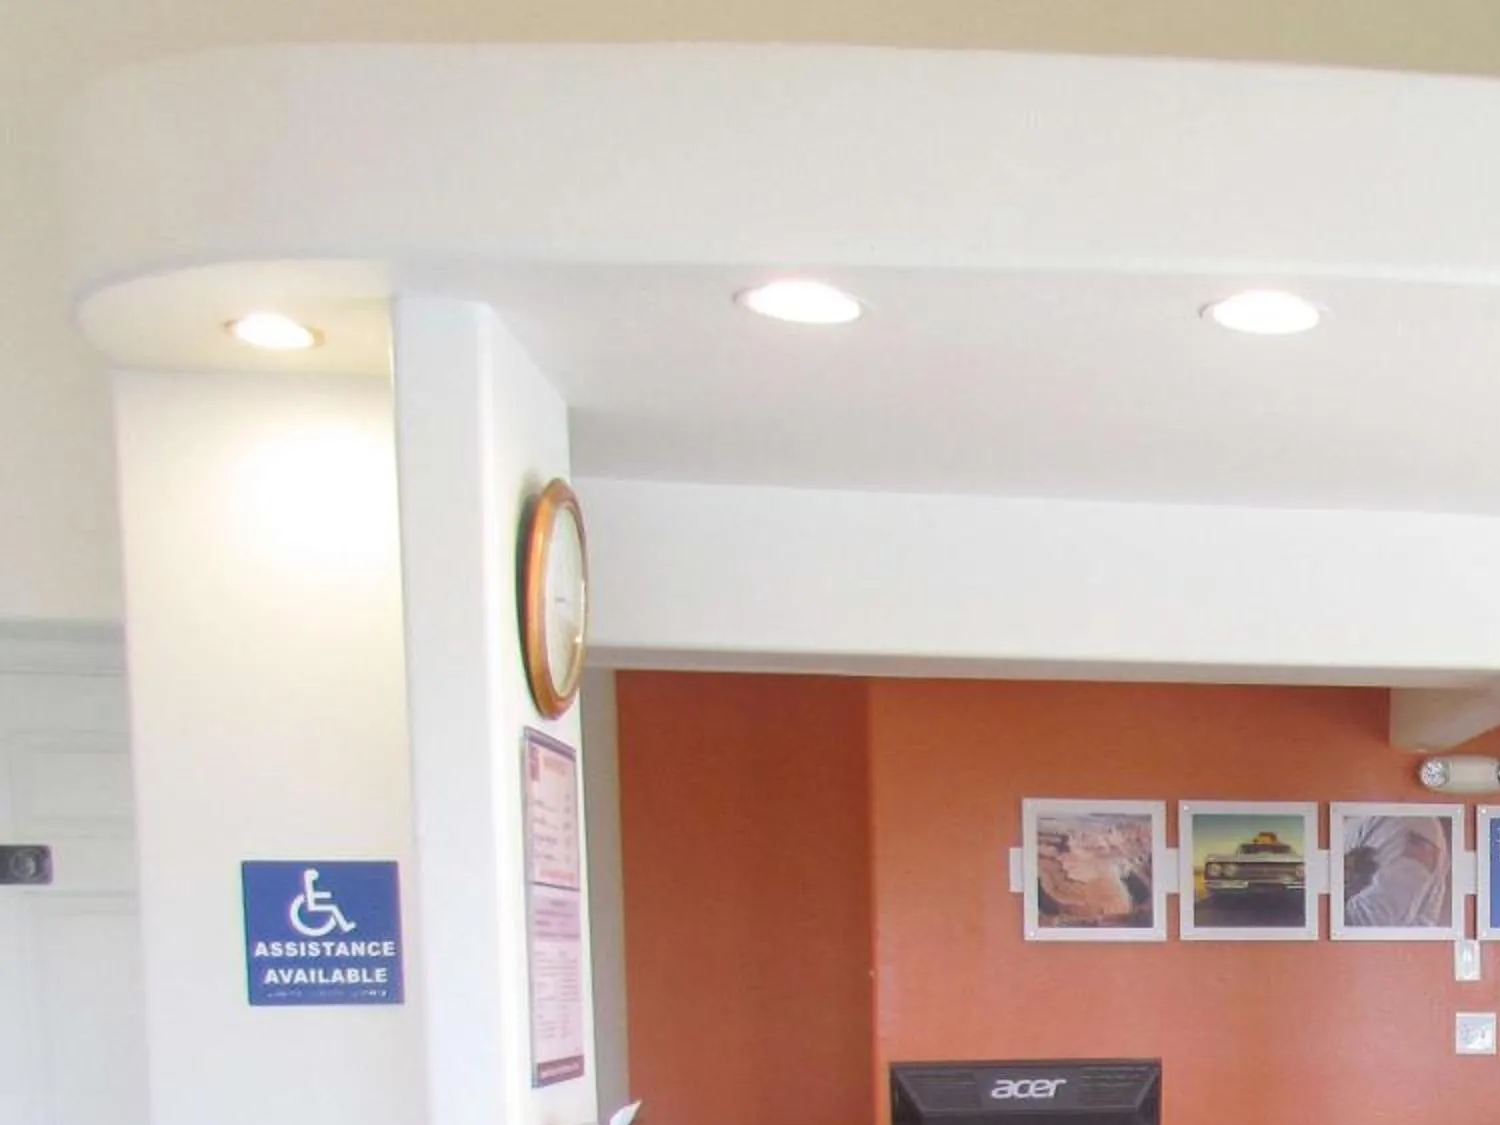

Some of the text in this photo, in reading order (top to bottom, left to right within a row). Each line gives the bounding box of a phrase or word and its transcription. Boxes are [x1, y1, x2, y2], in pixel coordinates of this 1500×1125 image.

[254, 941, 396, 957] ASSISTANCE
[264, 967, 388, 984] AVAILABLE
[990, 1078, 1067, 1099] acer
